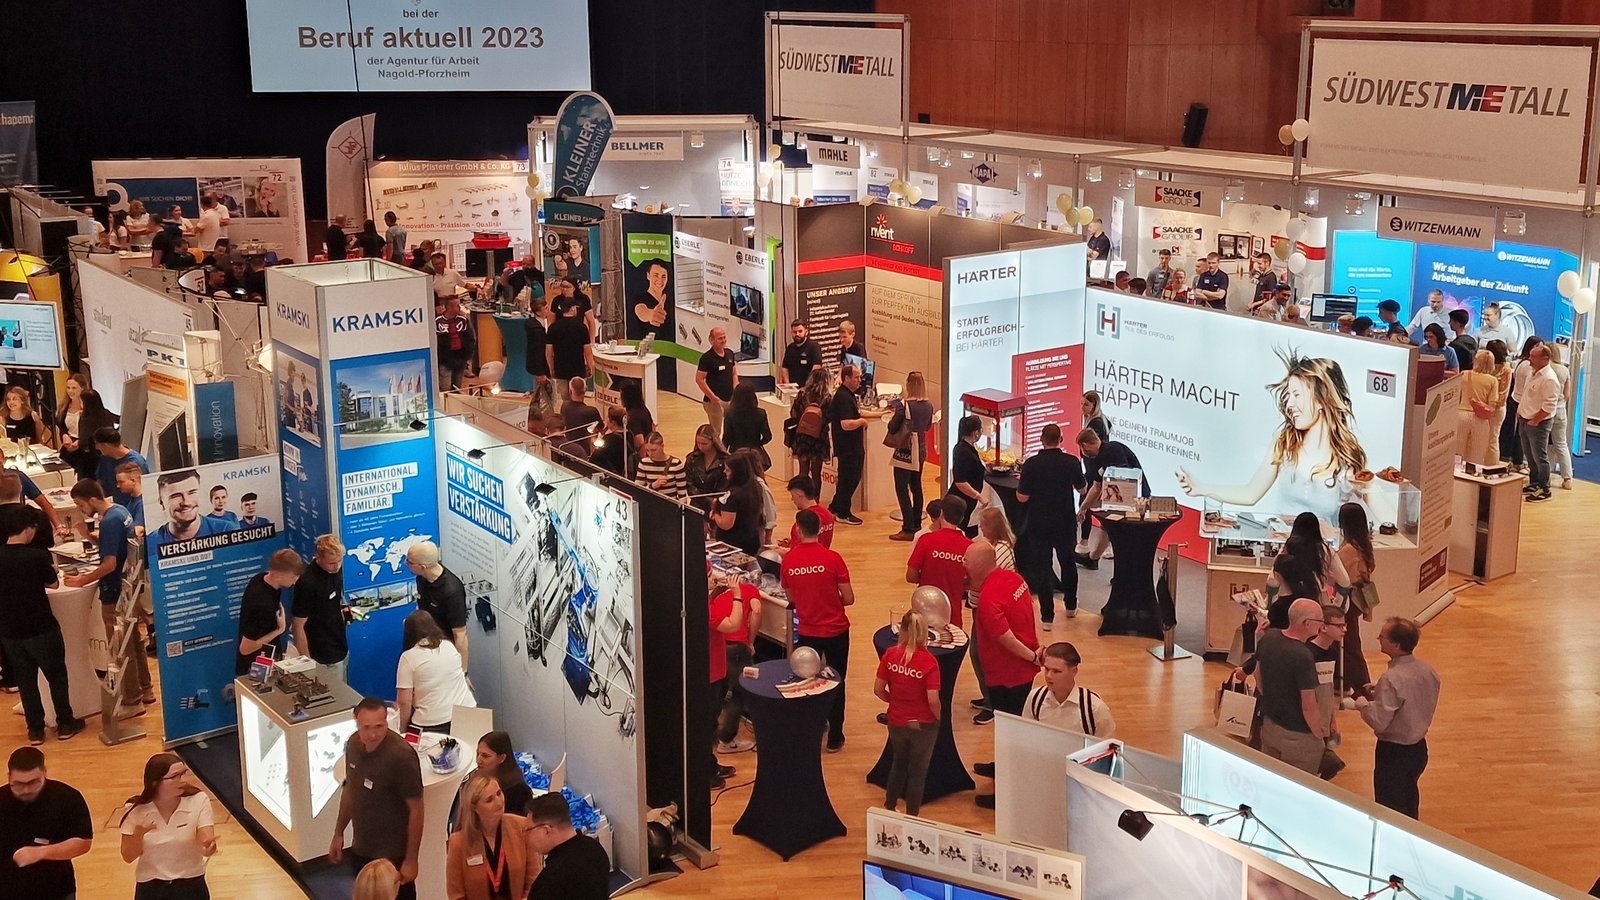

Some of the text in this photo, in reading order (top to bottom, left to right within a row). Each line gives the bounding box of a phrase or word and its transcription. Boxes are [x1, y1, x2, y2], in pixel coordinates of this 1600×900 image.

[403, 9, 439, 18] bei der
[298, 26, 544, 48] Beruf aktuell 2023
[367, 57, 479, 67] der Agentur für Arbeit
[779, 48, 895, 77] SÜDWESTMETALL
[378, 70, 470, 79] Nagold-Pforzheim
[1323, 72, 1571, 117] SÜDWESTMETALL
[562, 120, 597, 183] KLEINER
[611, 141, 665, 151] BELLMER
[575, 128, 607, 188] Stanztechnik
[818, 148, 848, 161] MAHLE
[399, 161, 512, 172] Julius Pfisterer GmbH & Co. KG
[516, 162, 526, 171] 73
[722, 160, 732, 168] 74
[273, 173, 282, 181] 72
[870, 169, 877, 178] 82
[1163, 187, 1193, 198] SAACKE
[1163, 197, 1193, 207] GROUP
[553, 213, 581, 221] KLEINER
[441, 221, 470, 229] Präzision
[1404, 220, 1482, 239] WITZENMANN
[681, 240, 700, 250] EBERLE
[744, 253, 765, 266] EBERLE
[1506, 252, 1551, 266] WITZENMANN
[957, 266, 1017, 284] HÄRTER
[1432, 261, 1465, 275] Wir sind
[1432, 273, 1529, 294] Arbeitgeber der Zukunft
[806, 286, 857, 298] UNSER ANGEBOT
[276, 301, 310, 329] KRAMSKI
[332, 308, 423, 333] KRAMSKI
[956, 315, 989, 328] STARTE
[1124, 319, 1148, 328] HÄRTER
[956, 323, 1017, 340] ERFOLGREICH
[956, 337, 1004, 352] BEI HÄRTER
[1093, 357, 1164, 394] HÄRTER
[1170, 378, 1240, 412] MACHT
[1372, 375, 1390, 394] 68
[1094, 382, 1152, 414] HÄPPY
[210, 400, 224, 455] Innovation
[1119, 418, 1194, 447] DEINEN TRAUMJOB
[1111, 429, 1202, 463] ARBEITGEBER KENNEN.
[223, 466, 271, 481] KRAMSKI
[344, 466, 416, 486] INTERNATIONAL.
[447, 456, 503, 505] WIR SUCHEN
[345, 482, 401, 499] DYNAMISCH.
[346, 499, 391, 514] FAMILIAR.
[449, 487, 512, 540] VERSTÄRKUNG
[615, 499, 628, 521] 43
[160, 526, 273, 557] VERSTÄRKUNG GESUCHT
[160, 556, 187, 567] KRAMSKI
[788, 565, 825, 576] DODUCO
[887, 662, 923, 679] DODUCO
